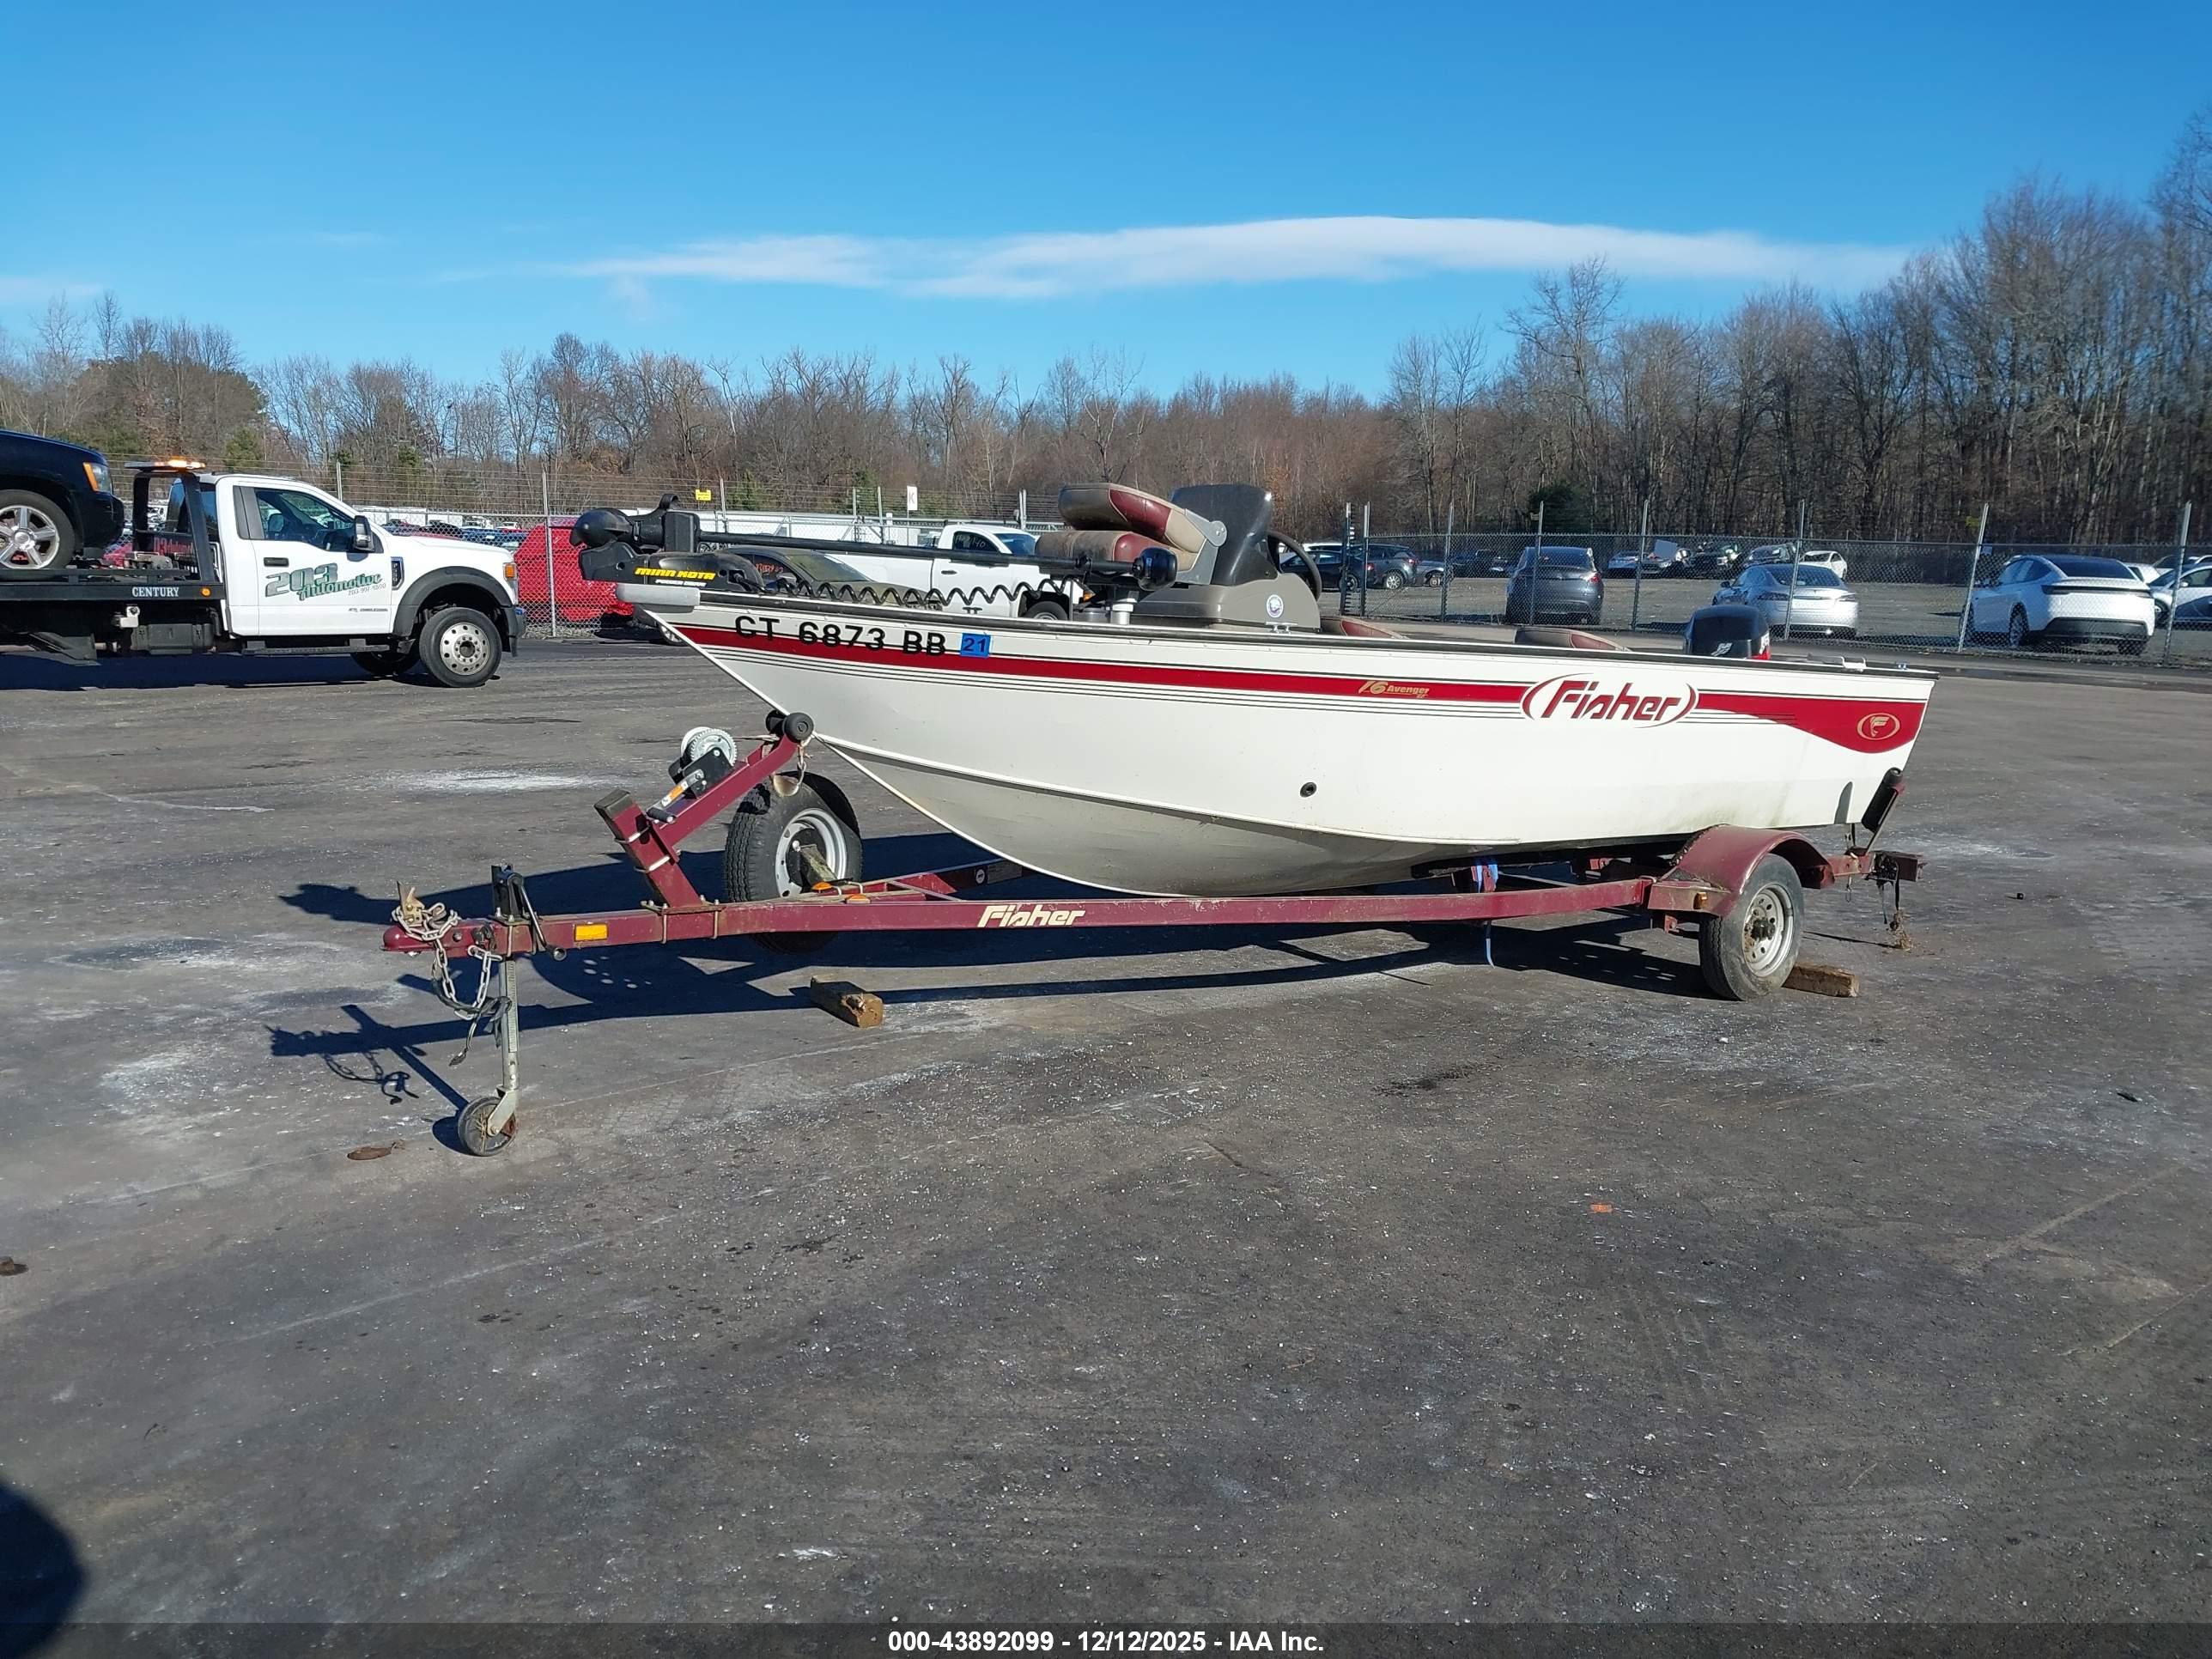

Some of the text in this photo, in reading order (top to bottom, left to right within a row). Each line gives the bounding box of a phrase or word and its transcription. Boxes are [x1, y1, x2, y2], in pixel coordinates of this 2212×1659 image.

[265, 562, 338, 598] 203
[635, 568, 716, 580] MINN KOTA
[131, 586, 179, 598] CENTURY
[296, 573, 383, 601] Automotive
[735, 616, 946, 656] CT 6873 BB
[963, 637, 987, 653] 21
[1387, 685, 1430, 695] Avenger
[1540, 680, 1682, 721] Fisher
[977, 904, 1086, 928] Fisher
